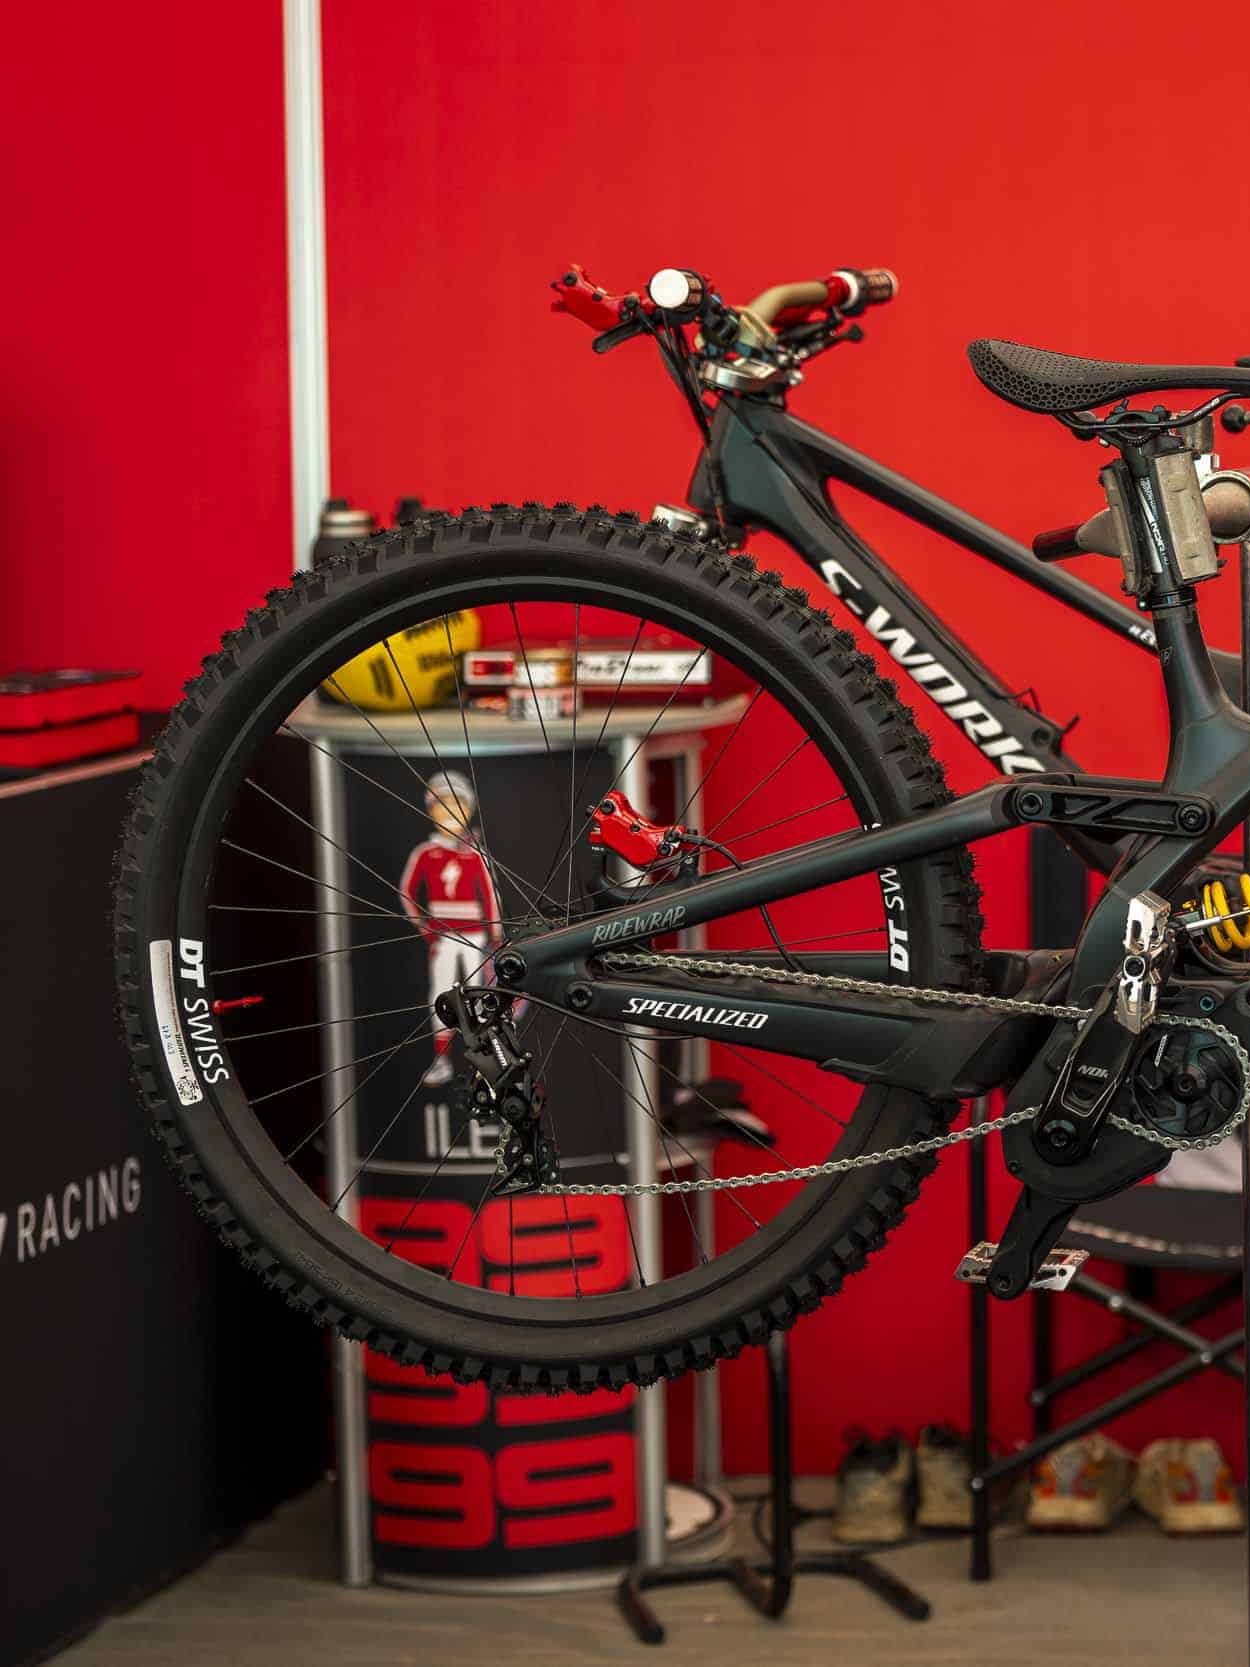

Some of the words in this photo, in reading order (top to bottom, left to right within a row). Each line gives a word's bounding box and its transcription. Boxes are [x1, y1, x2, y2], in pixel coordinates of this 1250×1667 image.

[819, 558, 1047, 776] S-WORK
[591, 905, 687, 944] RIDEWRAP
[888, 919, 909, 972] DT
[179, 938, 205, 988] DT
[622, 998, 768, 1029] SPECIALIZED
[184, 998, 229, 1084] SWISS
[17, 1156, 142, 1263] RACING
